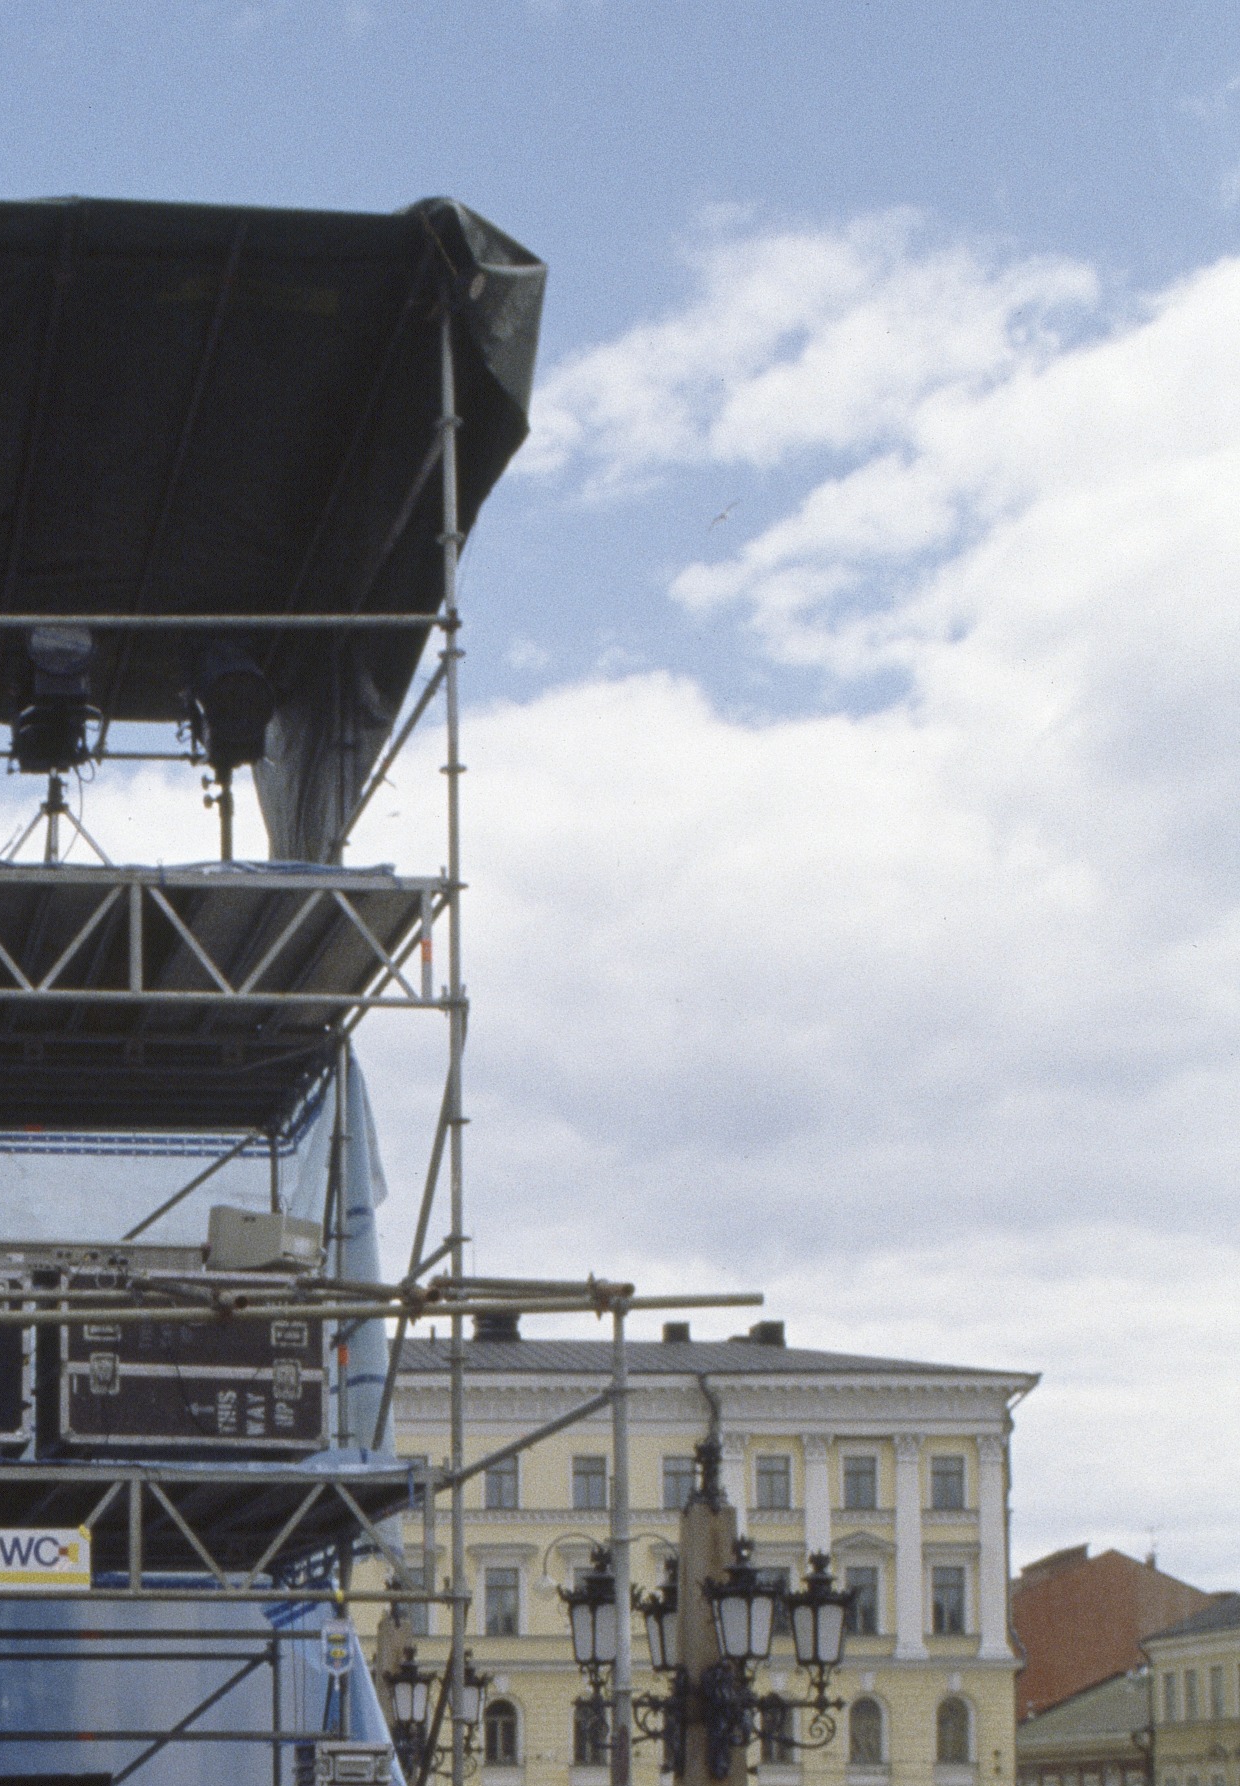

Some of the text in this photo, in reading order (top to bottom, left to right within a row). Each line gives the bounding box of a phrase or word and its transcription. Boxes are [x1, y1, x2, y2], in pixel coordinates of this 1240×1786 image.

[217, 1390, 238, 1434] THIS
[246, 1392, 266, 1436] WAY
[274, 1401, 295, 1429] UP
